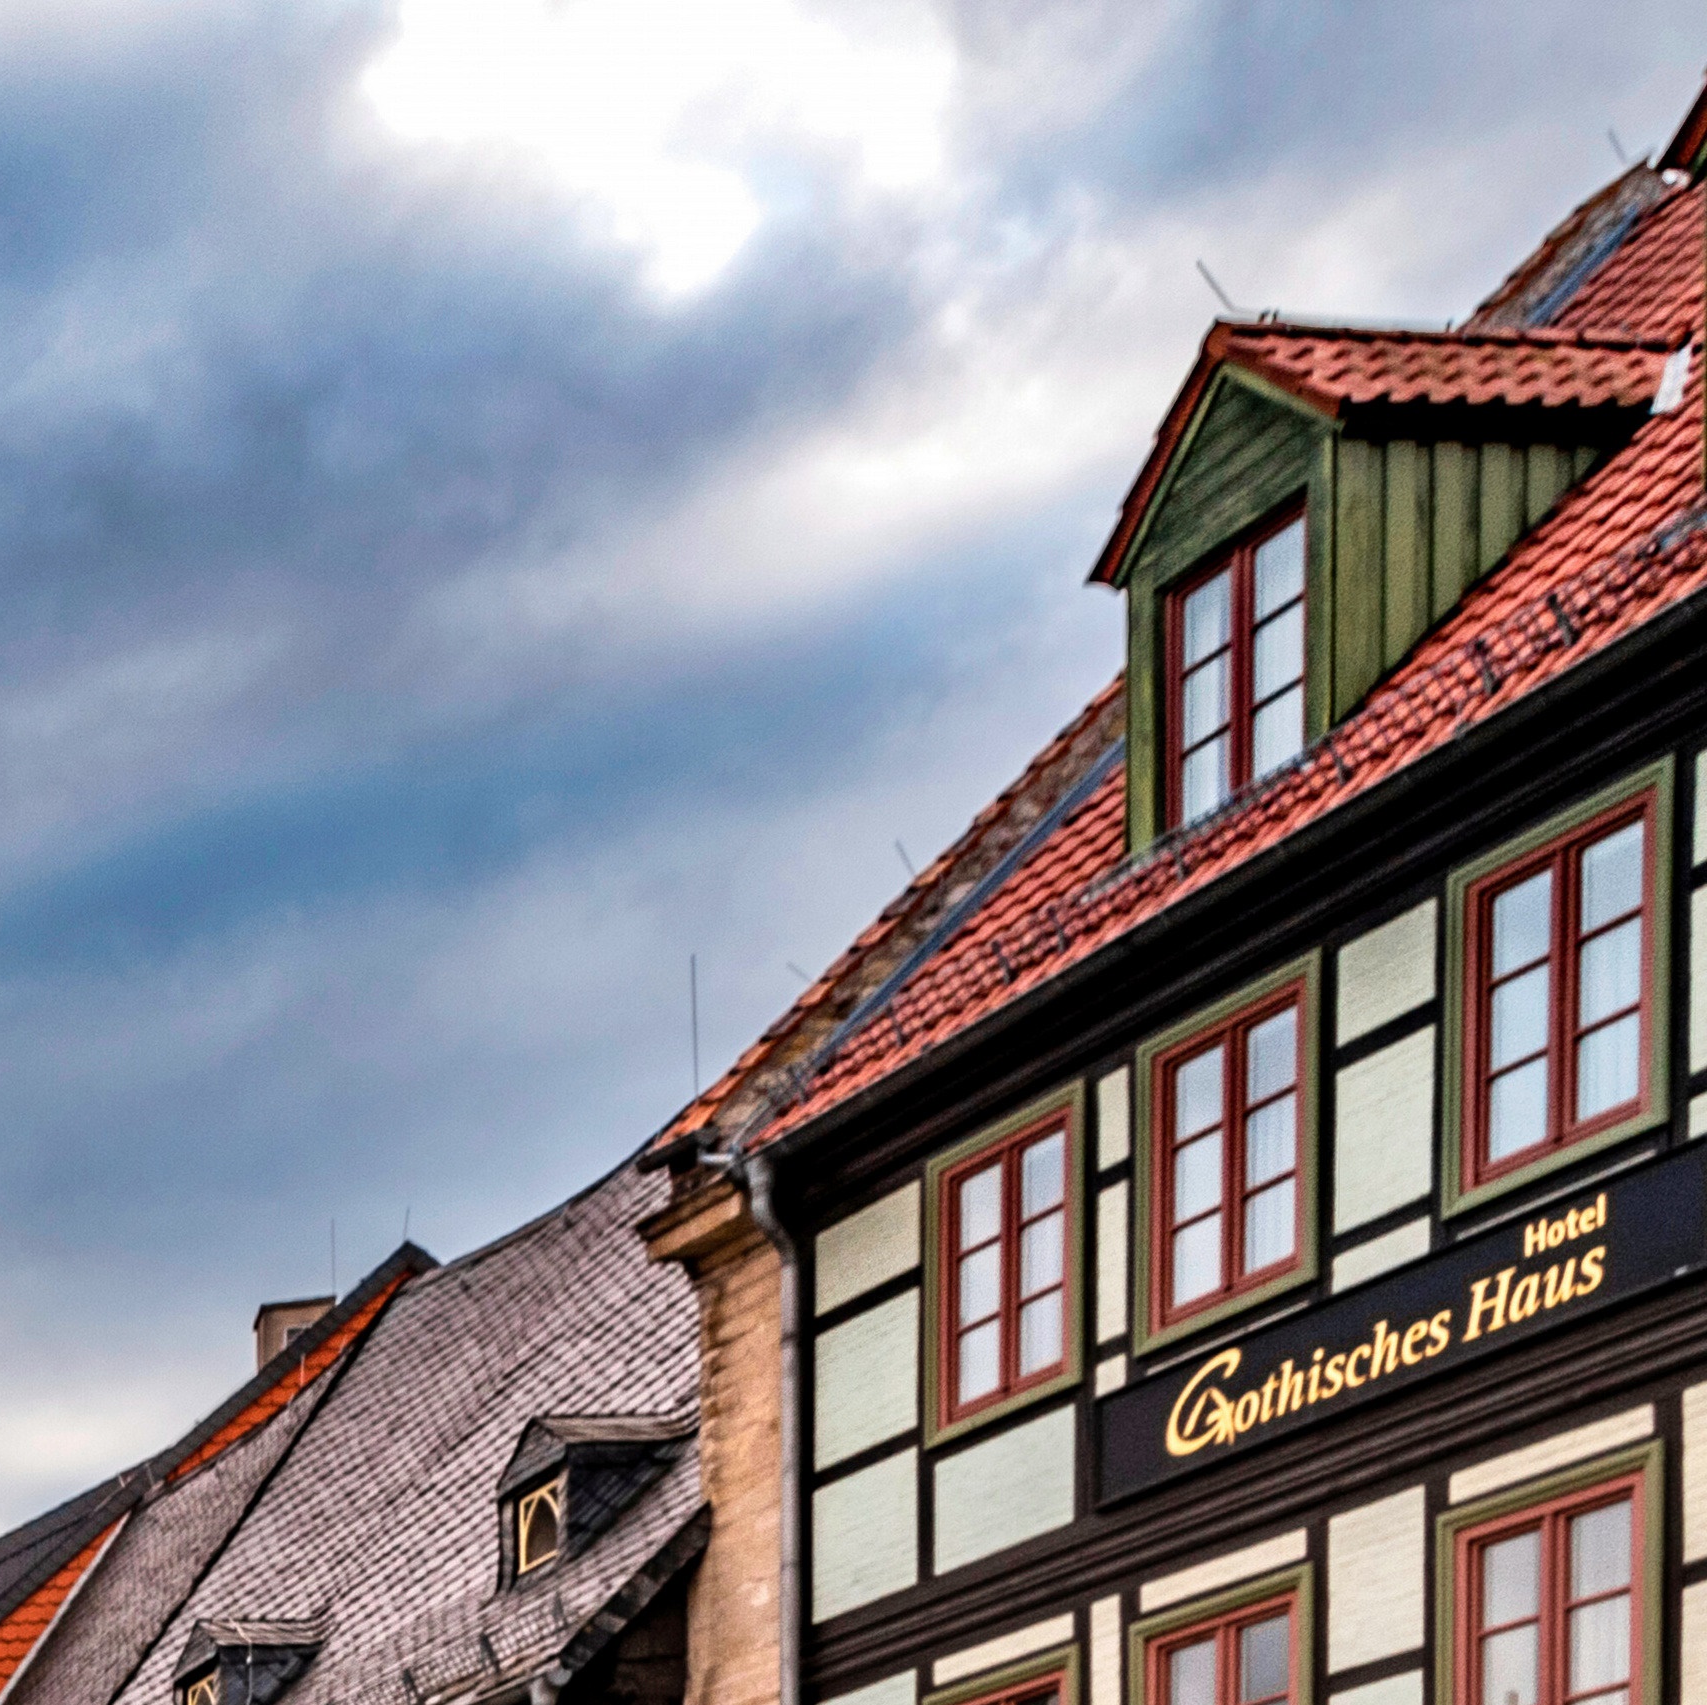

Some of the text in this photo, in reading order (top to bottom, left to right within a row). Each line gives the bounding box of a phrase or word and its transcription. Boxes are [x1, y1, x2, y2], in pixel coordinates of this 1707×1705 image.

[1524, 1192, 1607, 1258] Hotel
[1166, 1245, 1607, 1457] Gothisches Haus
